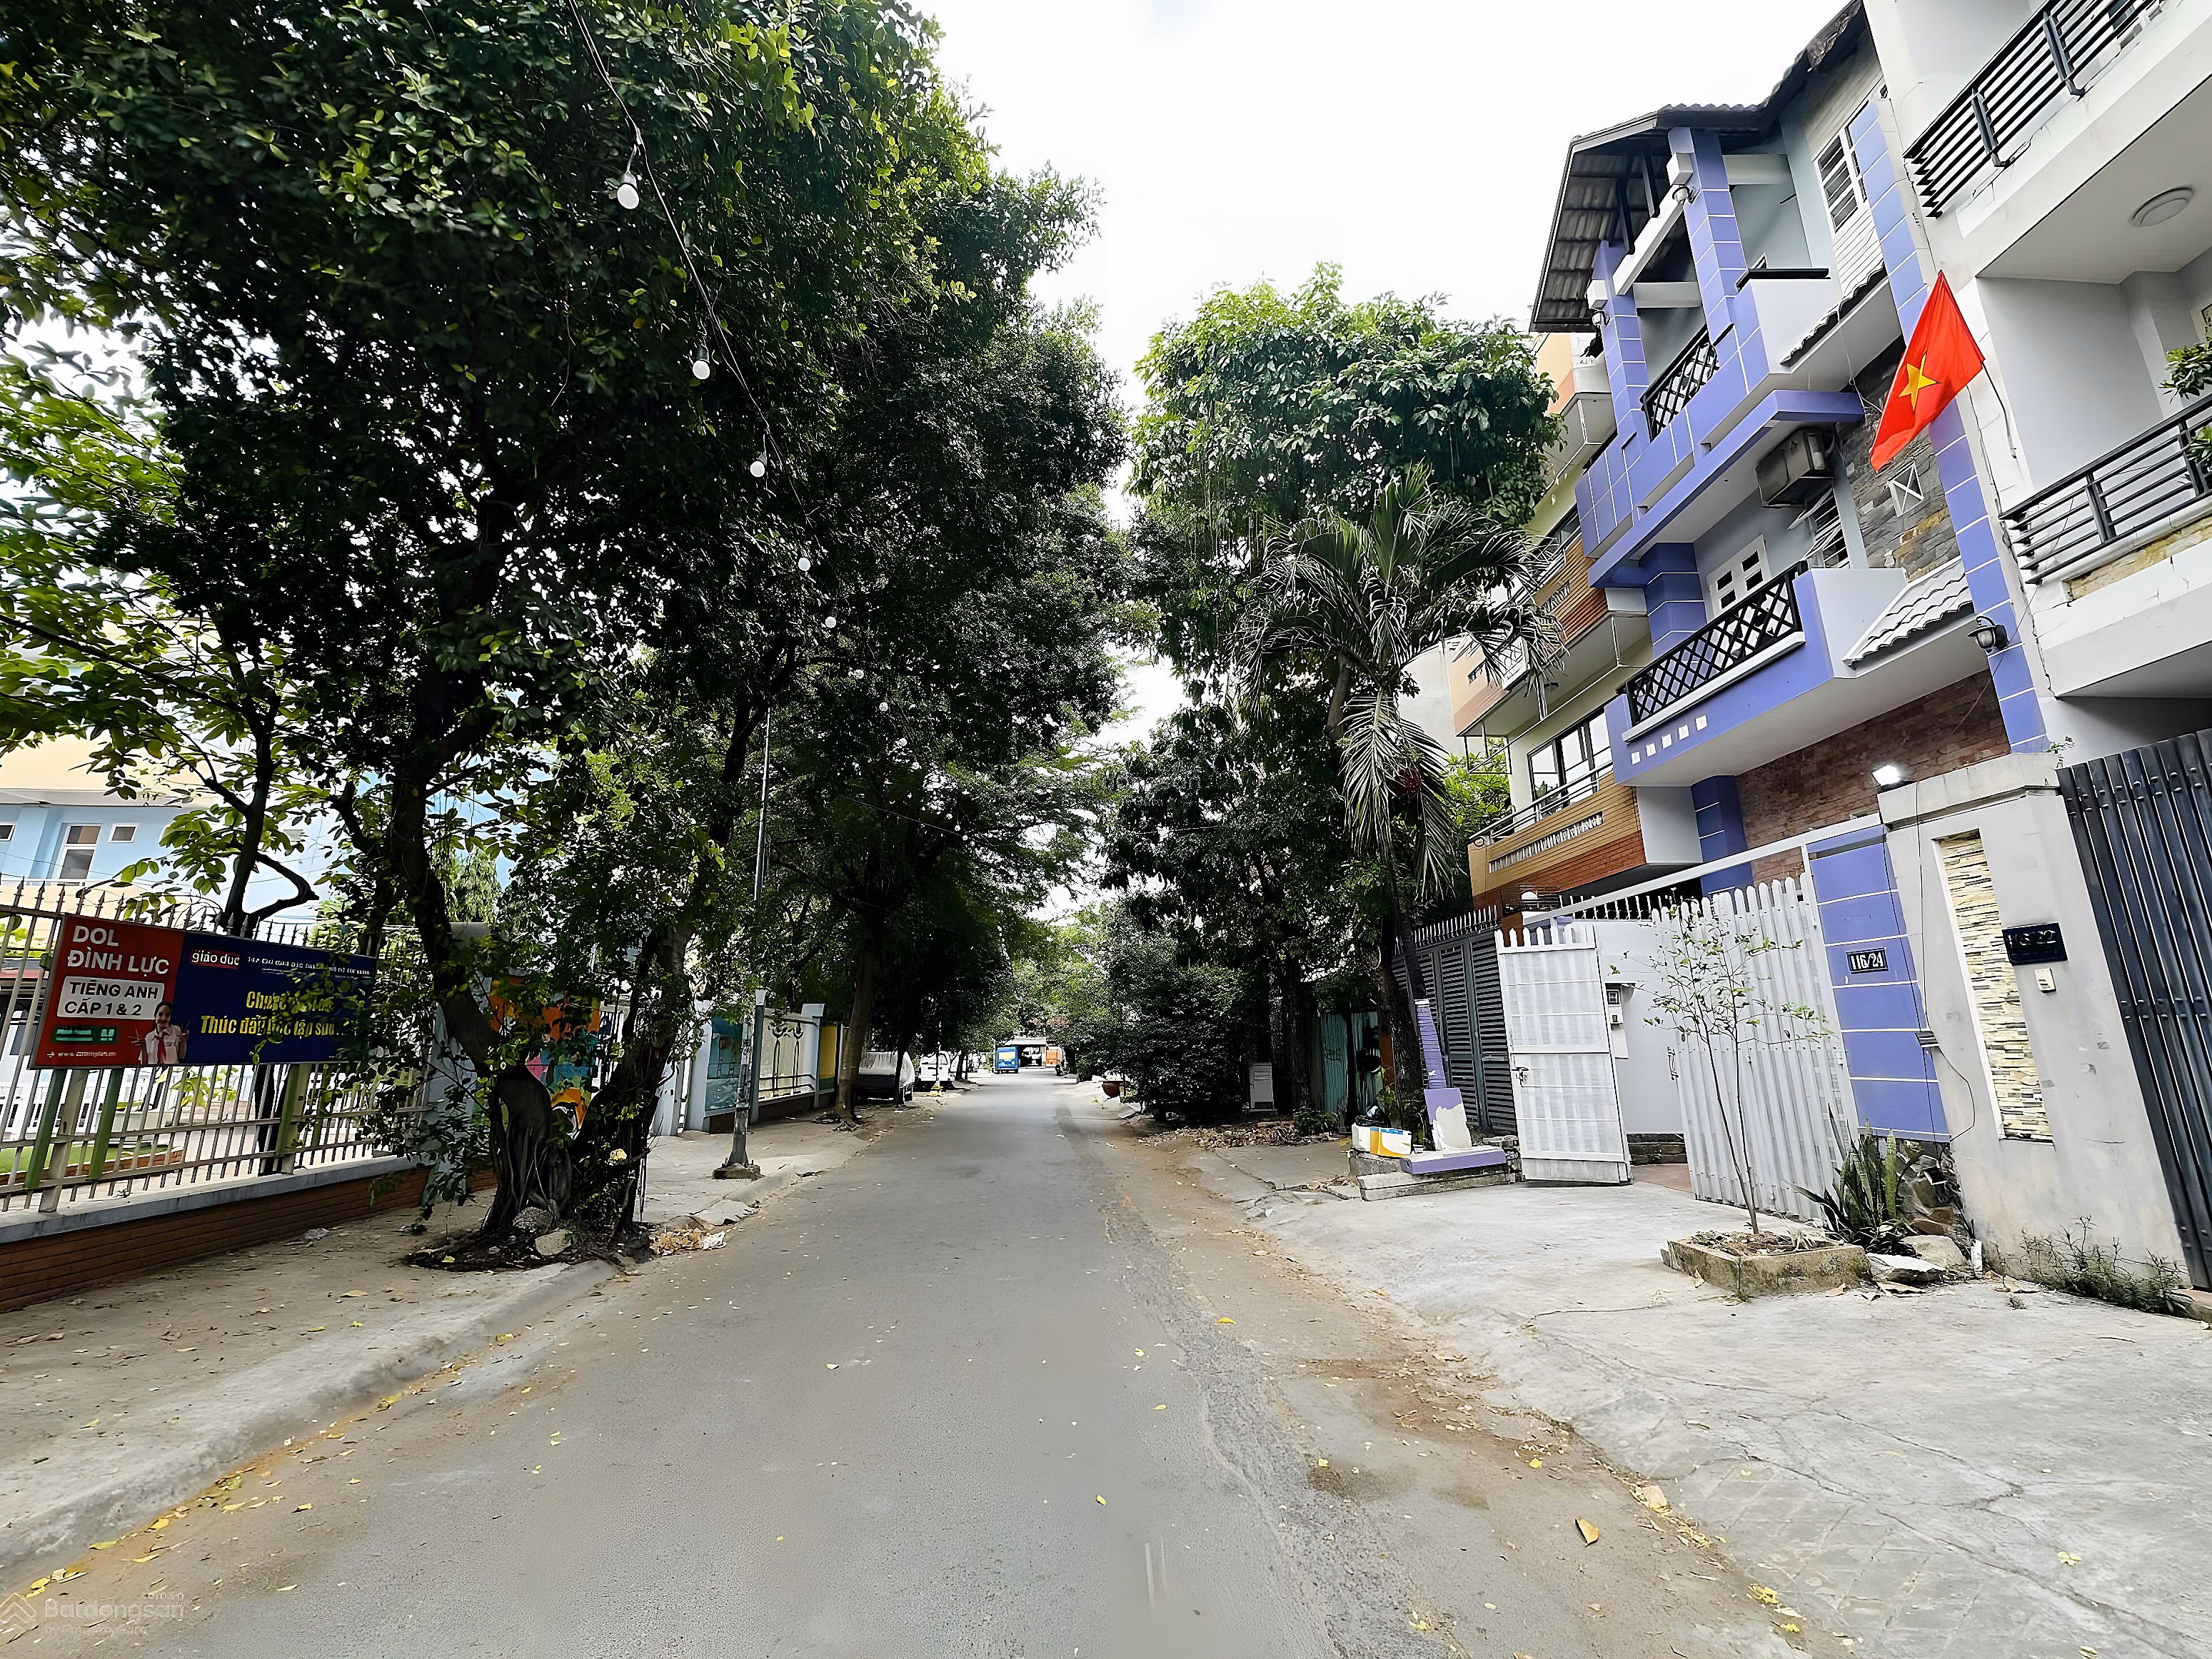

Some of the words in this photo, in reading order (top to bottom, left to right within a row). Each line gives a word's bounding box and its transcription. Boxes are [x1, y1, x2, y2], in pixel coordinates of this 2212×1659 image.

[72, 925, 119, 947] DOL
[67, 946, 123, 971] ĐÌNH
[127, 956, 169, 977] LỰC
[1850, 952, 1884, 969] 116/24
[69, 979, 121, 997] TIẾNG
[124, 985, 159, 999] ANH
[64, 997, 102, 1015] CẤP
[106, 1002, 113, 1015] 1
[116, 1003, 128, 1016] &
[131, 1004, 142, 1016] 2
[201, 1015, 237, 1034] Thúc
